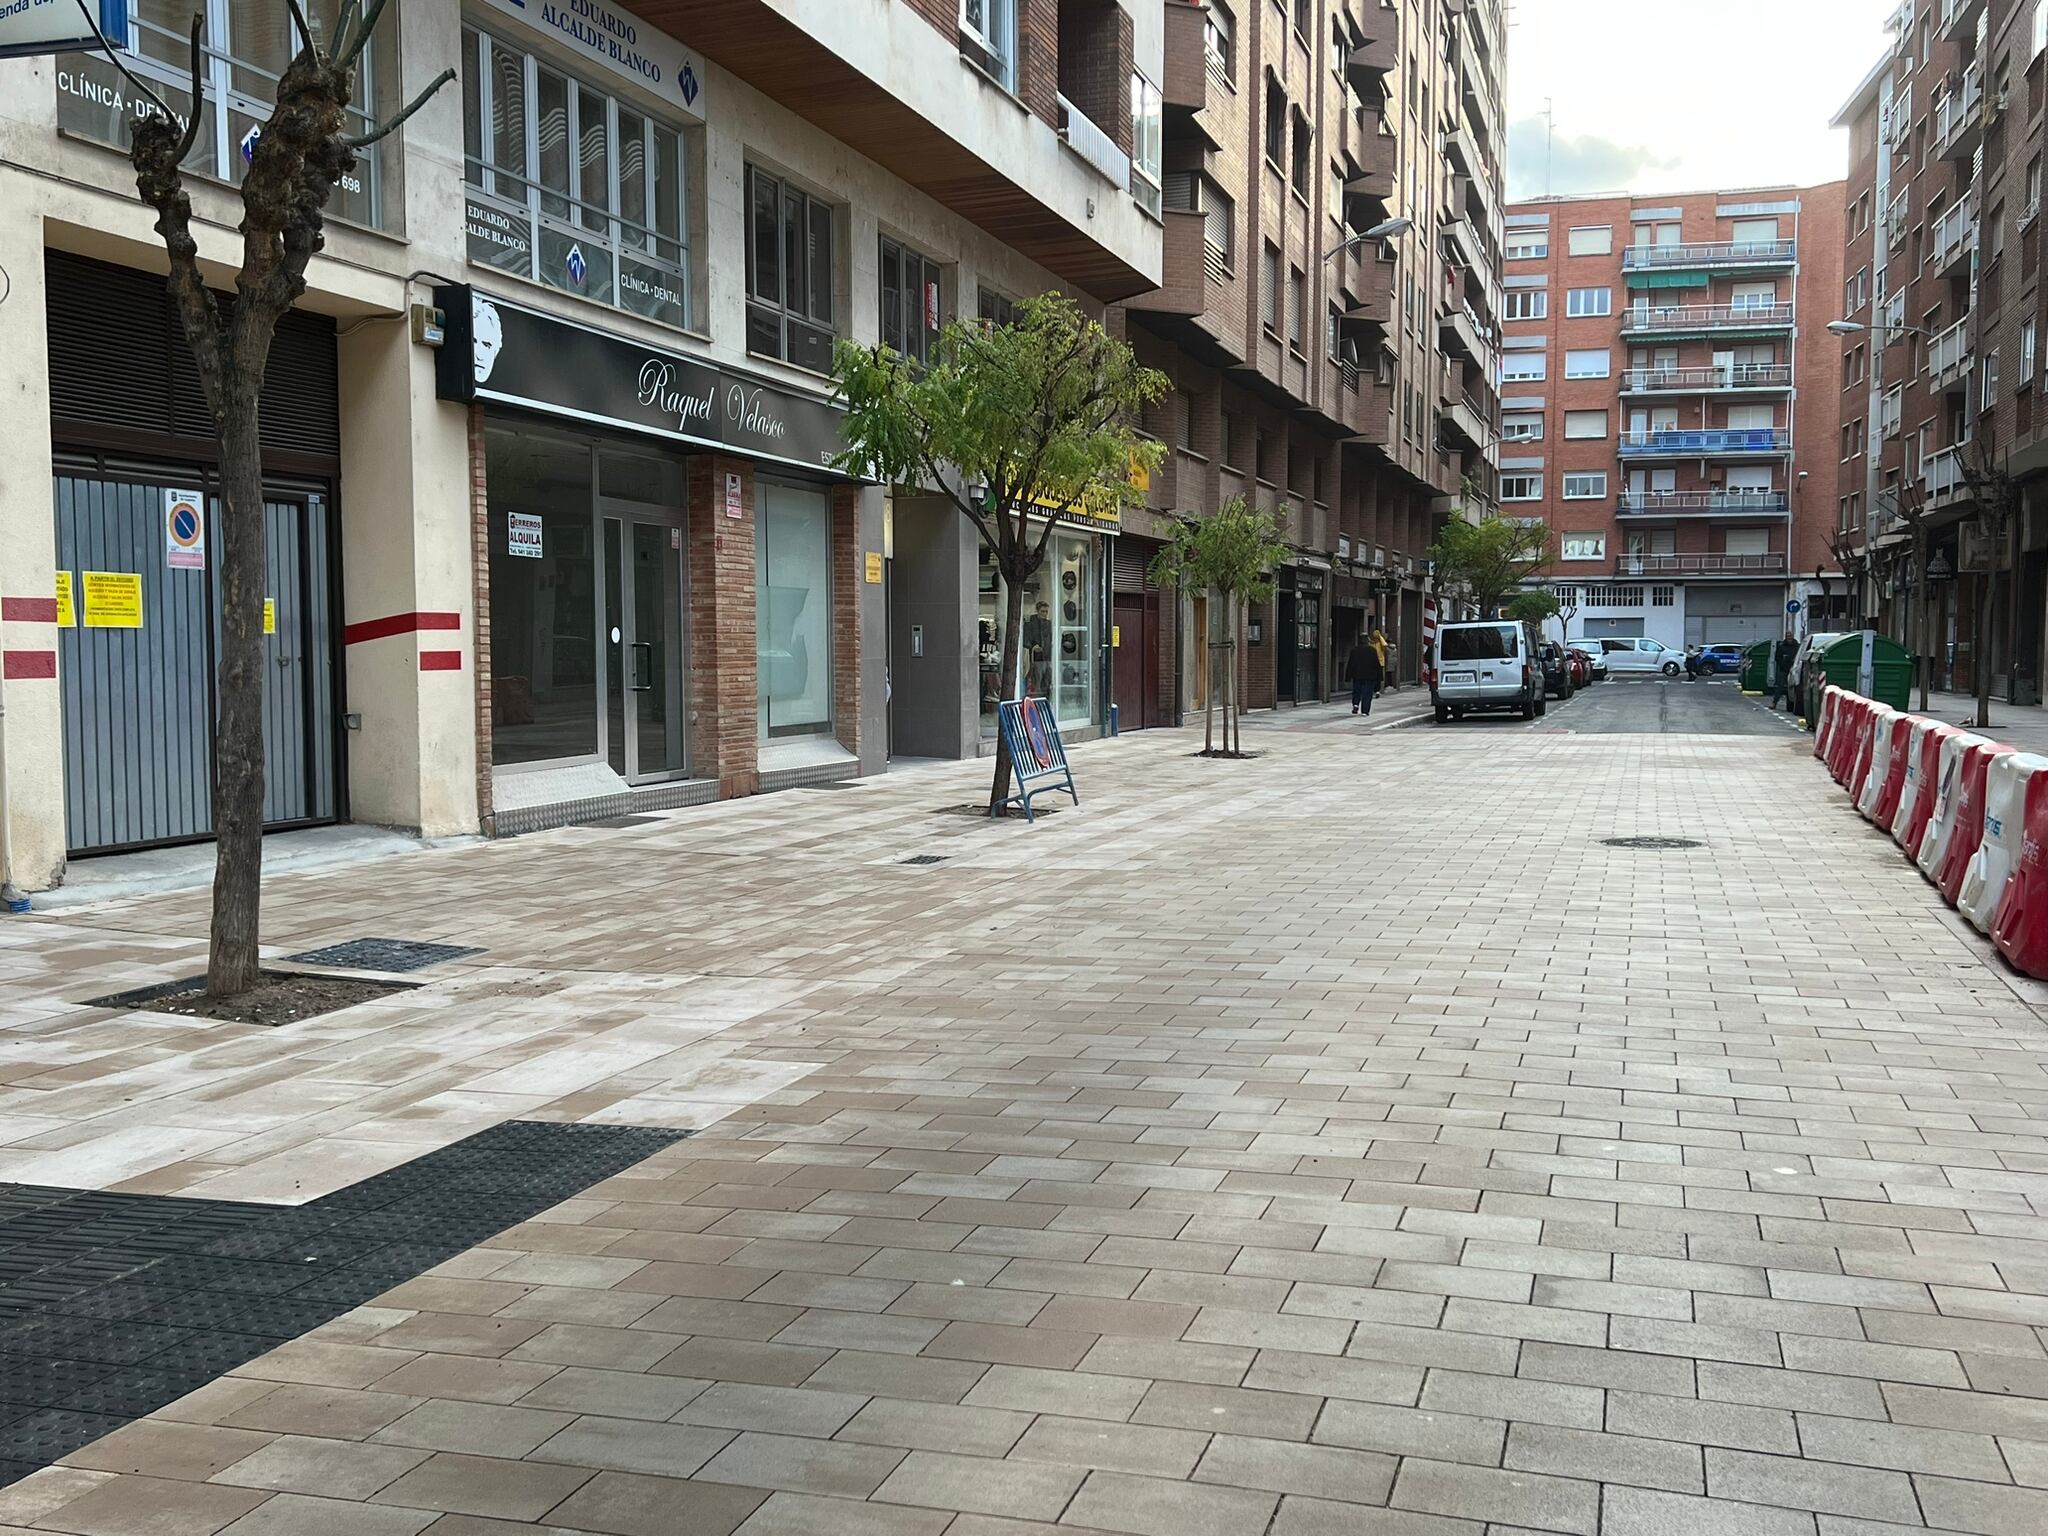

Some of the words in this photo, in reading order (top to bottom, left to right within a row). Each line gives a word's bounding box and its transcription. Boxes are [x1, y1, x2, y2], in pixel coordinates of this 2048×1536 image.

[570, 0, 637, 45] EDUARDO
[541, 2, 606, 53] ALCALDE
[608, 38, 661, 83] BLANCO
[58, 72, 123, 111] CLÍNICA
[467, 205, 510, 230] EDUARDO
[491, 227, 526, 252] BLANCO
[621, 273, 650, 295] CLÍNICA
[654, 287, 681, 306] DENTAL
[638, 358, 714, 431] Raquel
[726, 384, 786, 440] Velasco
[510, 518, 541, 528] HERREROS
[510, 531, 541, 545] ALQUILA
